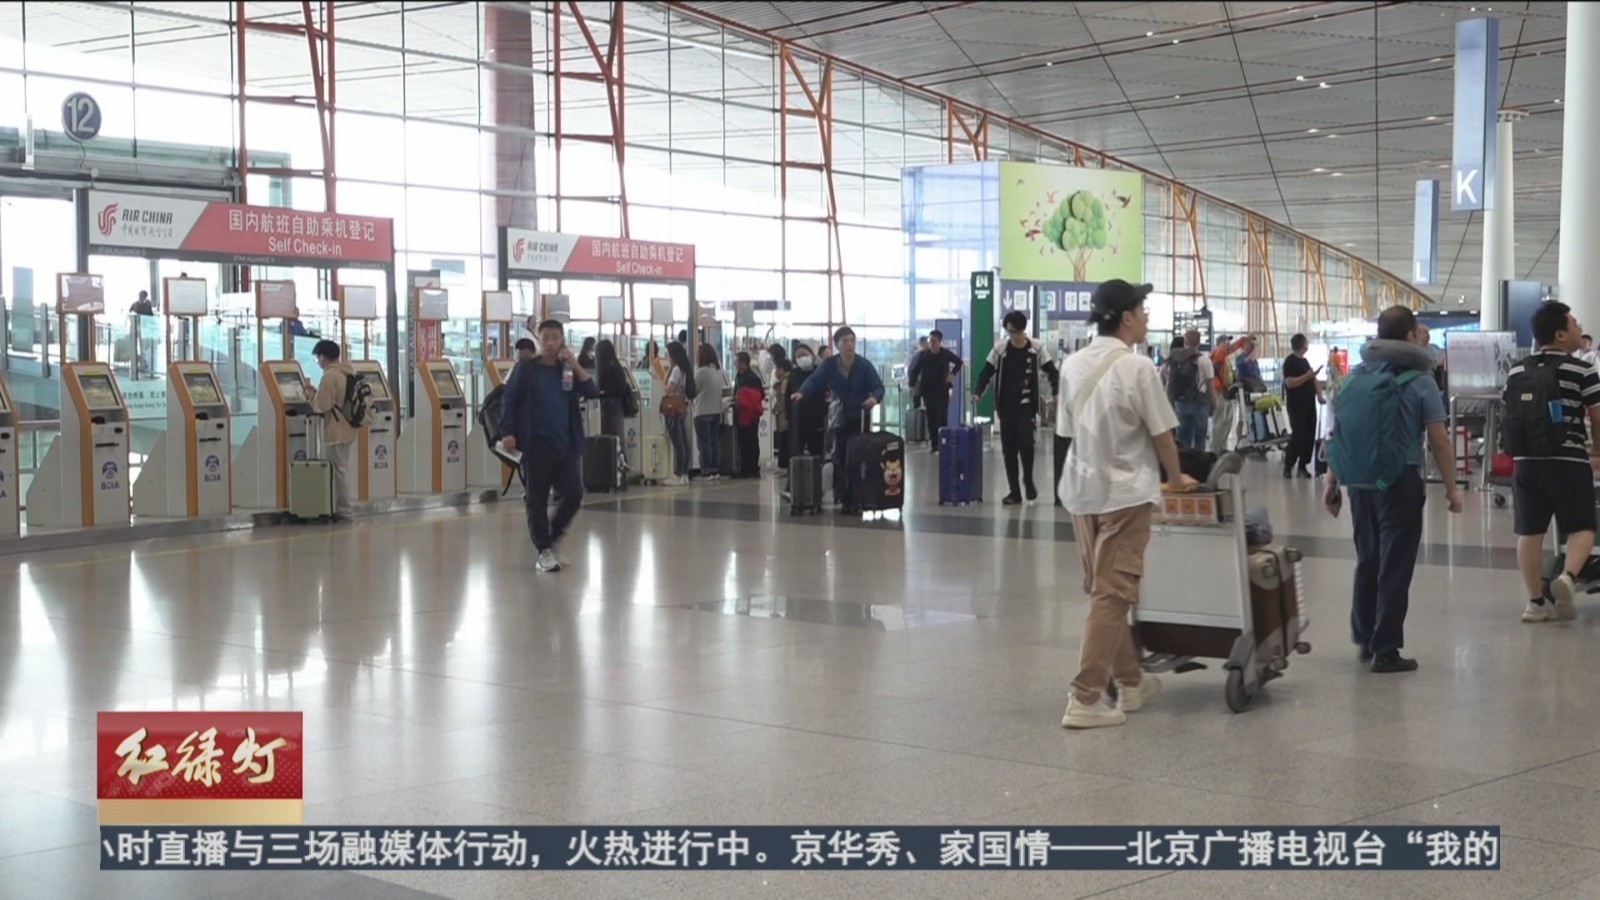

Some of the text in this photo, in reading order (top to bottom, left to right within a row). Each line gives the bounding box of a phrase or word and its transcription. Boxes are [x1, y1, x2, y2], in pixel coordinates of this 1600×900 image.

[67, 96, 95, 133] 12
[1456, 168, 1479, 205] K
[122, 208, 173, 225] AIR CHINA
[229, 208, 376, 242] 国内航班自助乘机登记
[268, 236, 343, 256] Self Check-in
[527, 241, 538, 251] AIR
[591, 239, 684, 264] 国内航班自助乘机登记
[616, 262, 662, 276] Self Check-in
[1416, 262, 1427, 282] L
[100, 481, 120, 491] BCIA
[204, 473, 221, 483] BCIA
